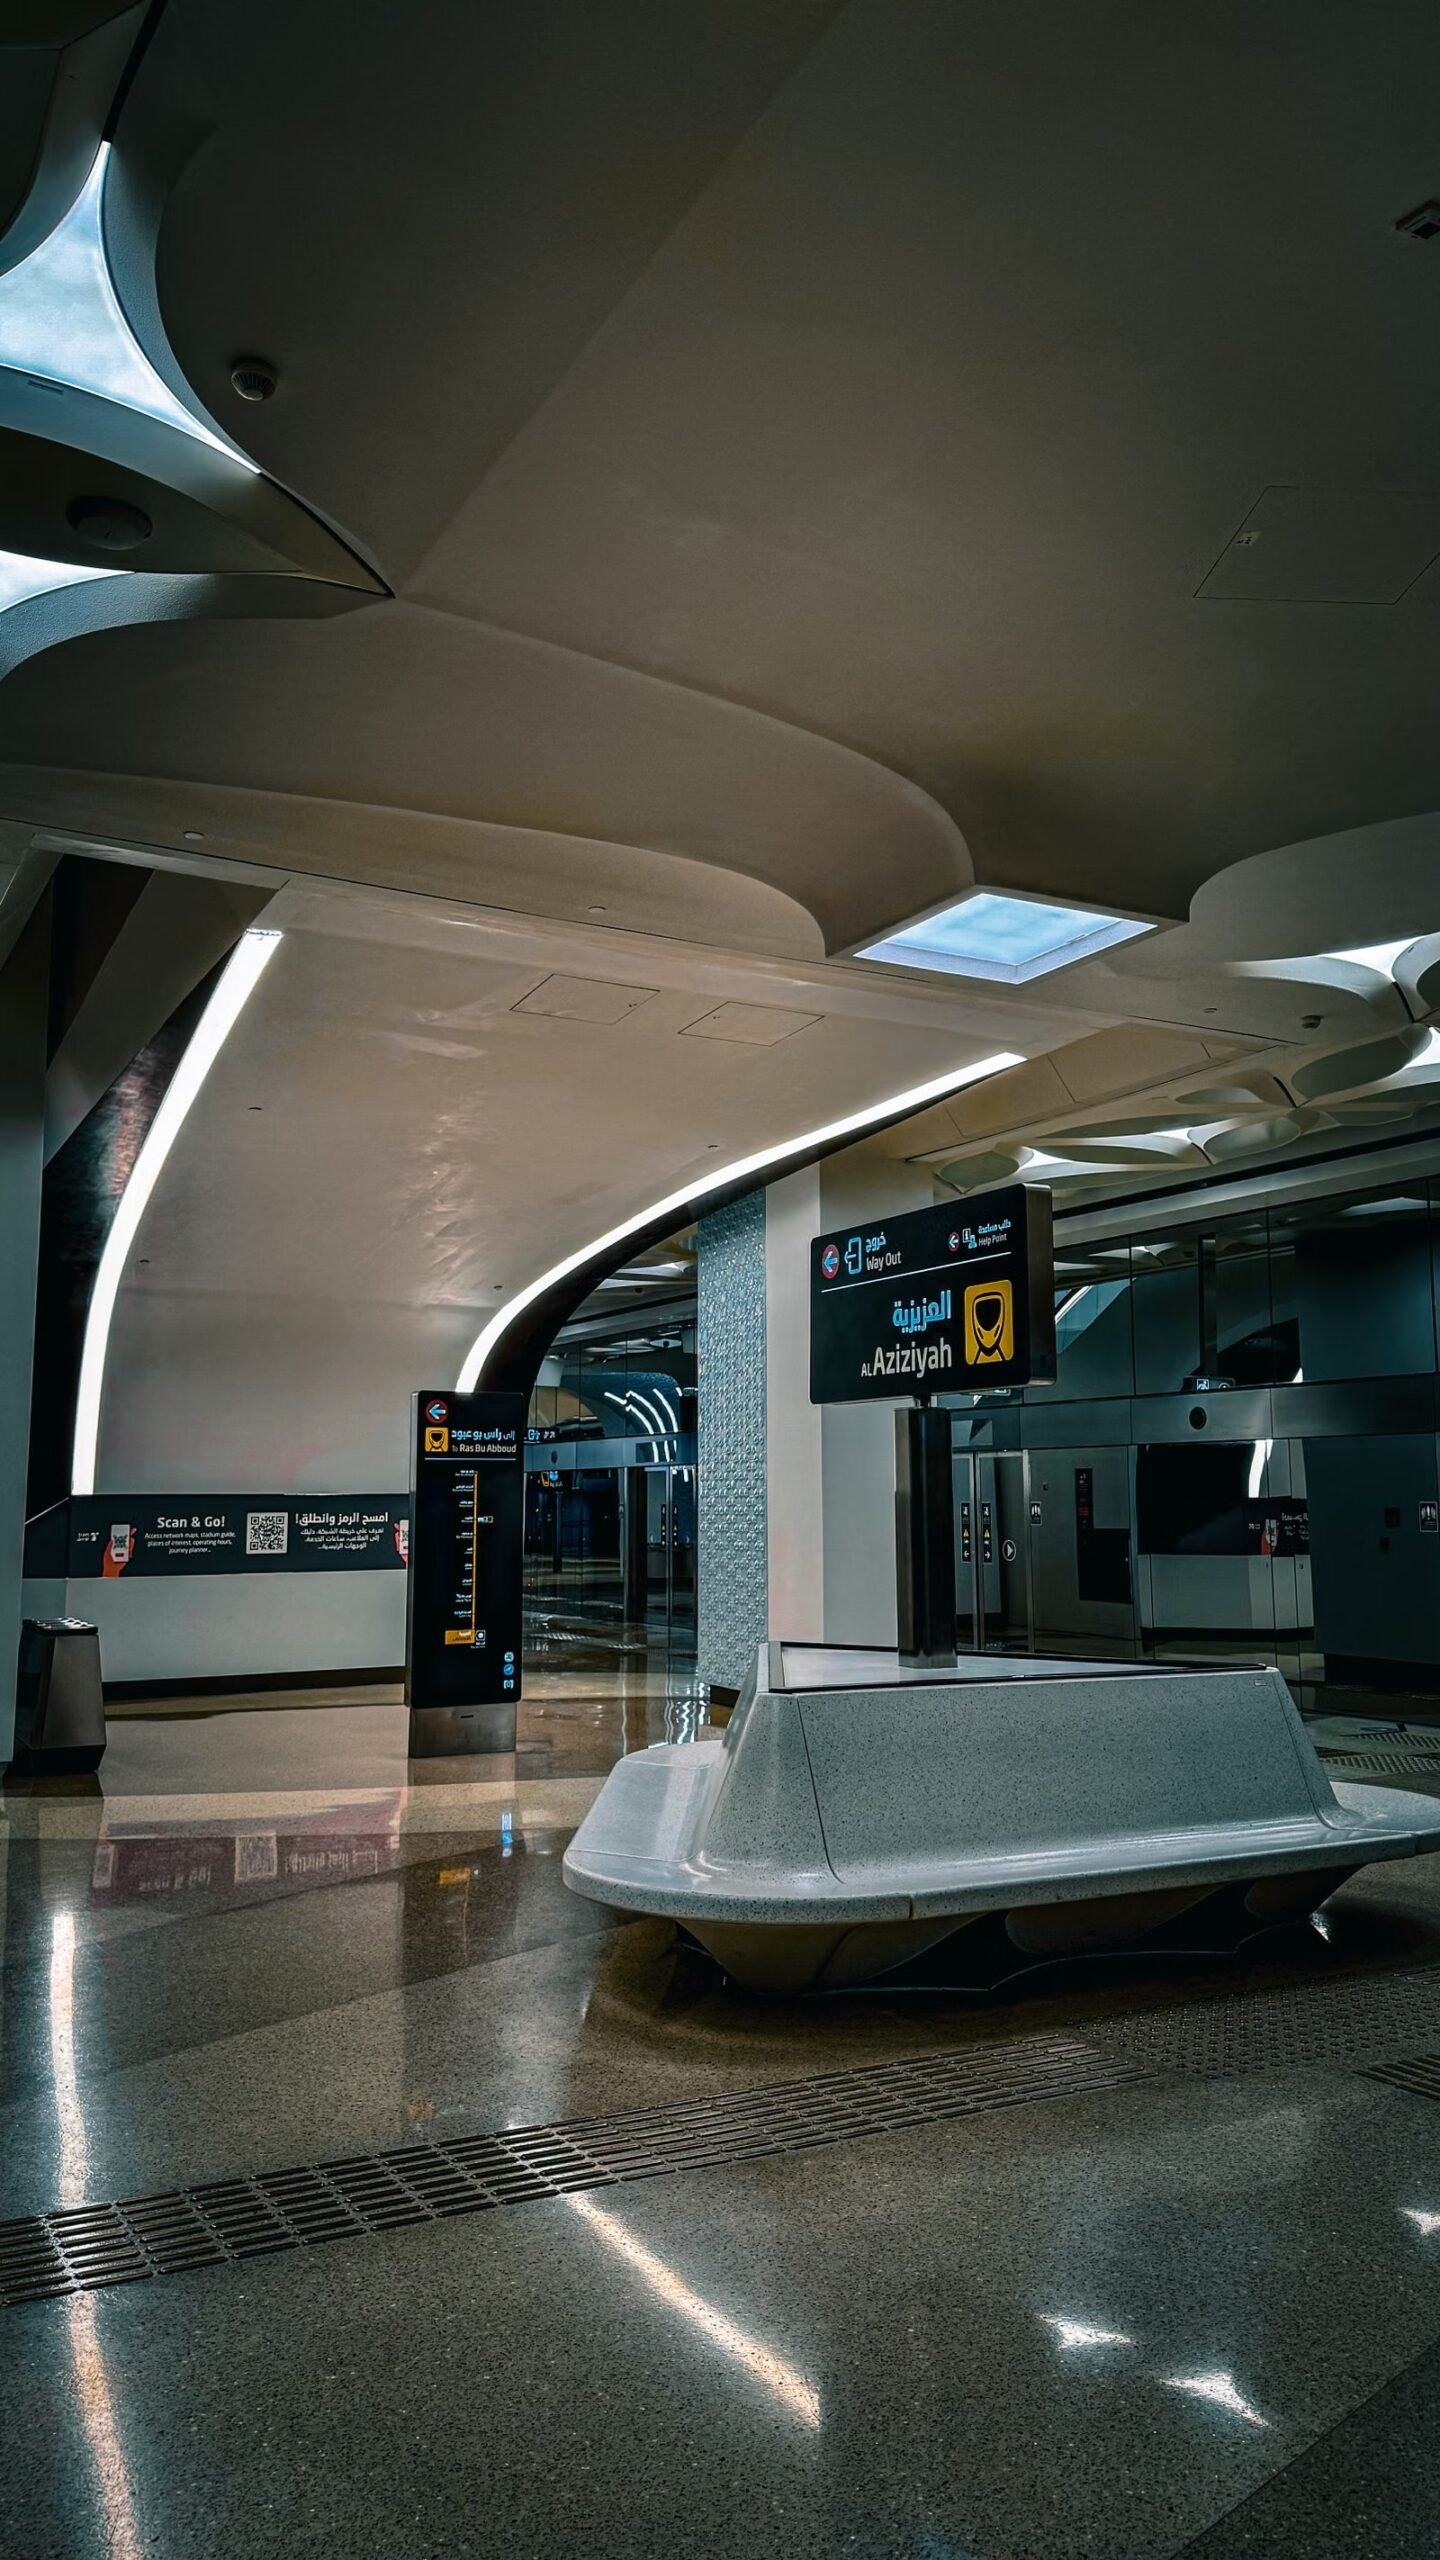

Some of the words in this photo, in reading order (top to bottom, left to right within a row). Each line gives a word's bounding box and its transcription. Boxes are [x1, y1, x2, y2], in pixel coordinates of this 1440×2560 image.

[865, 1231, 887, 1253] خروج
[978, 1236, 992, 1247] Help
[991, 1232, 1007, 1244] Point
[866, 1255, 884, 1271] Way
[885, 1250, 902, 1266] Out
[892, 1289, 952, 1334] العزيزية
[872, 1336, 953, 1379] Aziziyah
[459, 1443, 474, 1453] Ras
[475, 1443, 486, 1453] Bu
[486, 1443, 517, 1453] Abboud
[157, 1516, 188, 1529] Scan
[191, 1515, 201, 1528] &
[204, 1515, 226, 1528] Go!
[295, 1512, 336, 1527] وانطلق!
[337, 1512, 360, 1526] الرمز
[362, 1511, 389, 1526] امسح
